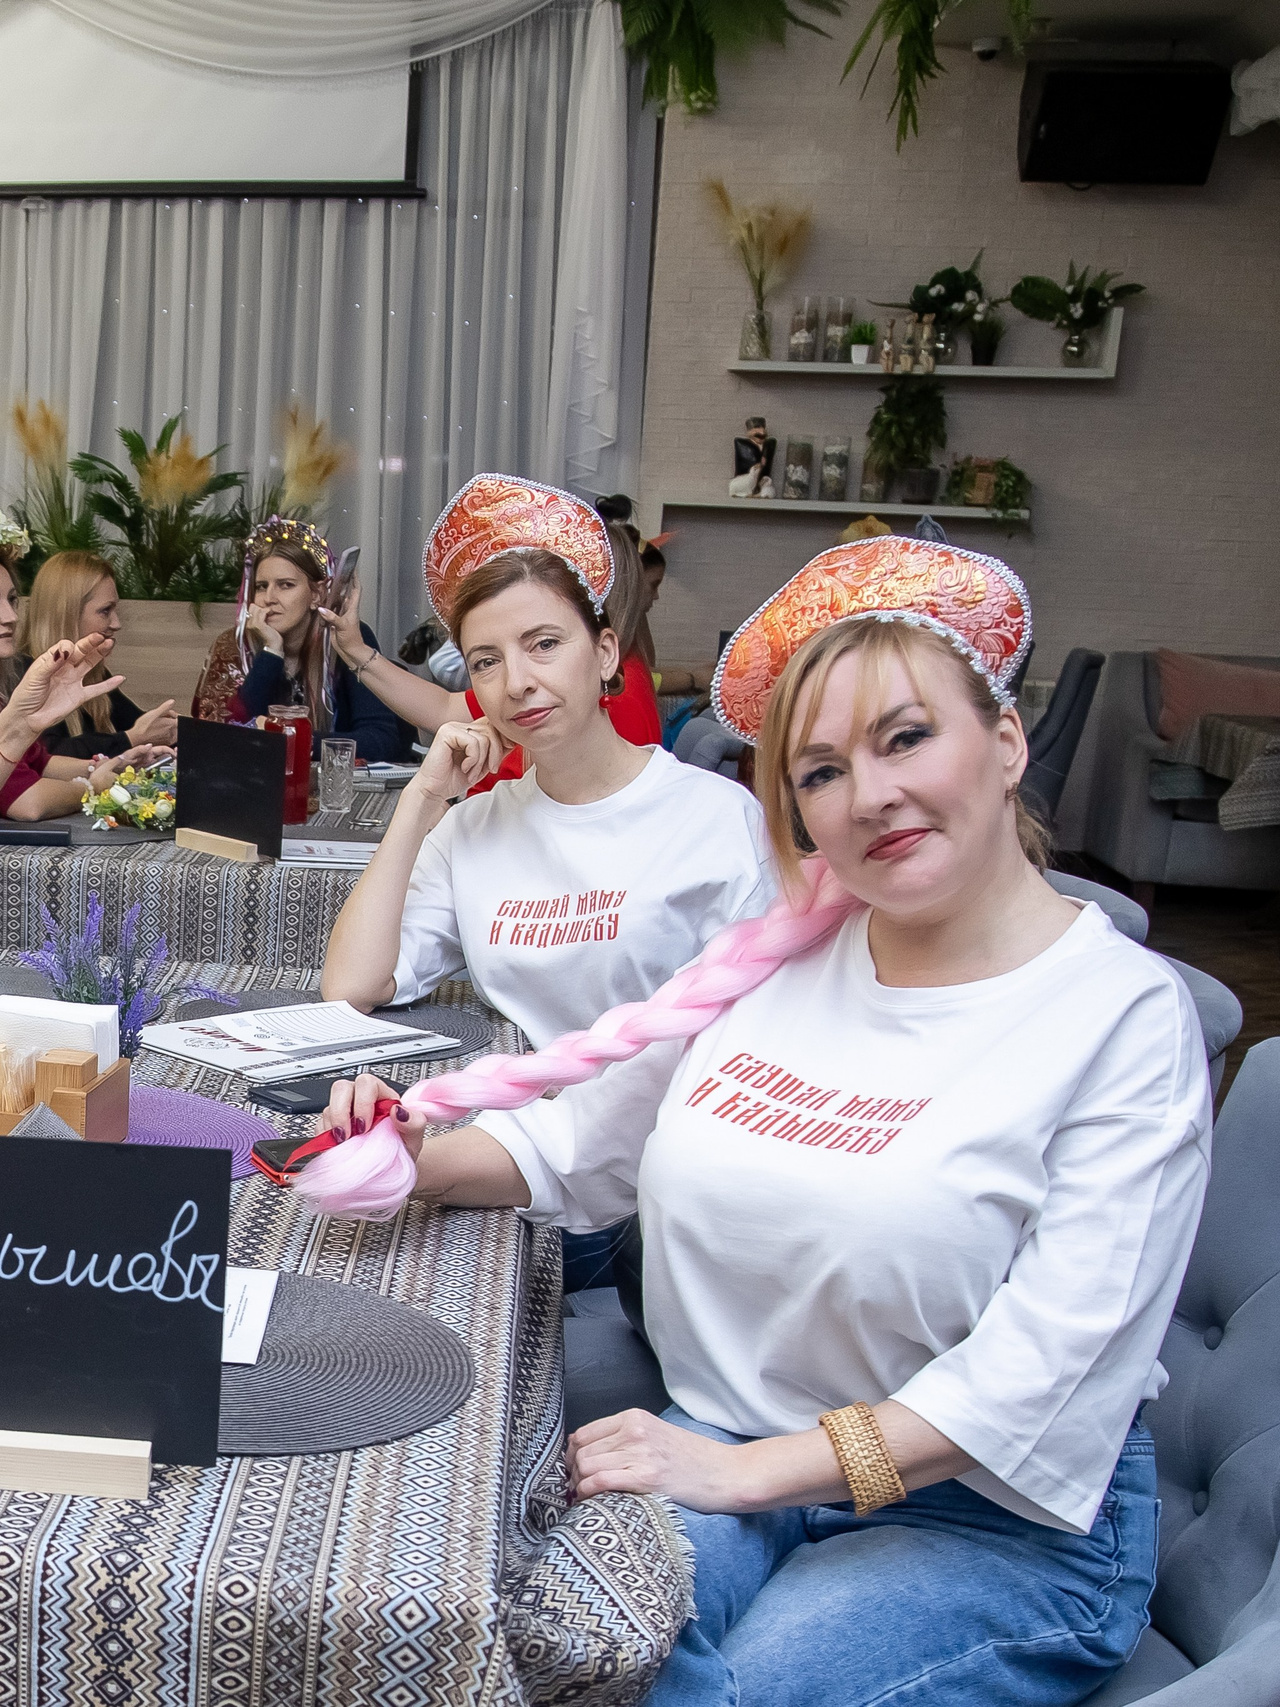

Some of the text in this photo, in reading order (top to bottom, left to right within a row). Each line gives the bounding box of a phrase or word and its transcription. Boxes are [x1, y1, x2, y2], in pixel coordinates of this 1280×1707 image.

[496, 889, 627, 919] СЛУШАЙ МАМУ
[489, 913, 619, 949] И КАДЫШЕВУ
[718, 1052, 934, 1122] СЛУШАЙ МАМУ
[684, 1076, 903, 1155] И КАДЫШЕВУ
